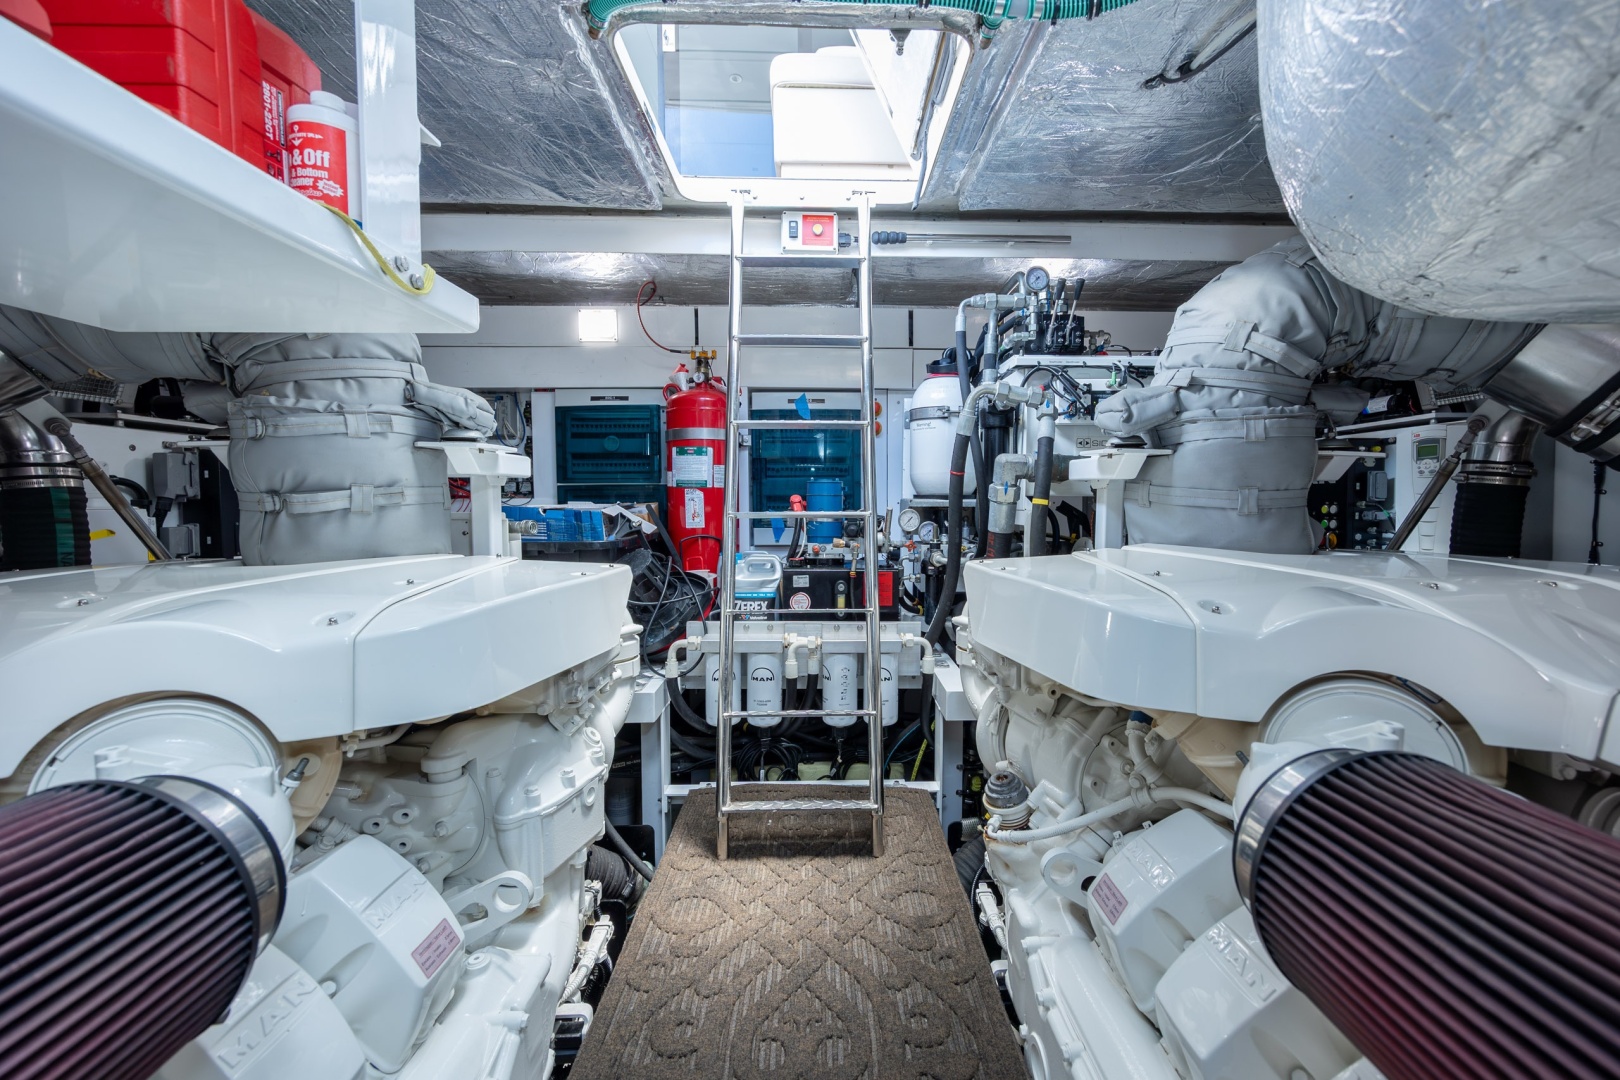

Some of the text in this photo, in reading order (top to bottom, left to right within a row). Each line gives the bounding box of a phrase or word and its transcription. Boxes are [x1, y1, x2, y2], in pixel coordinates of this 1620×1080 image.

[262, 80, 274, 140] 2801-22CT
[292, 148, 330, 168] & Off
[296, 168, 328, 178] Bottom
[734, 600, 768, 612] ZEREX
[1126, 840, 1171, 888] MAN
[365, 875, 428, 930] MAN
[1205, 926, 1278, 1002] MAN
[217, 977, 318, 1070] MAN
